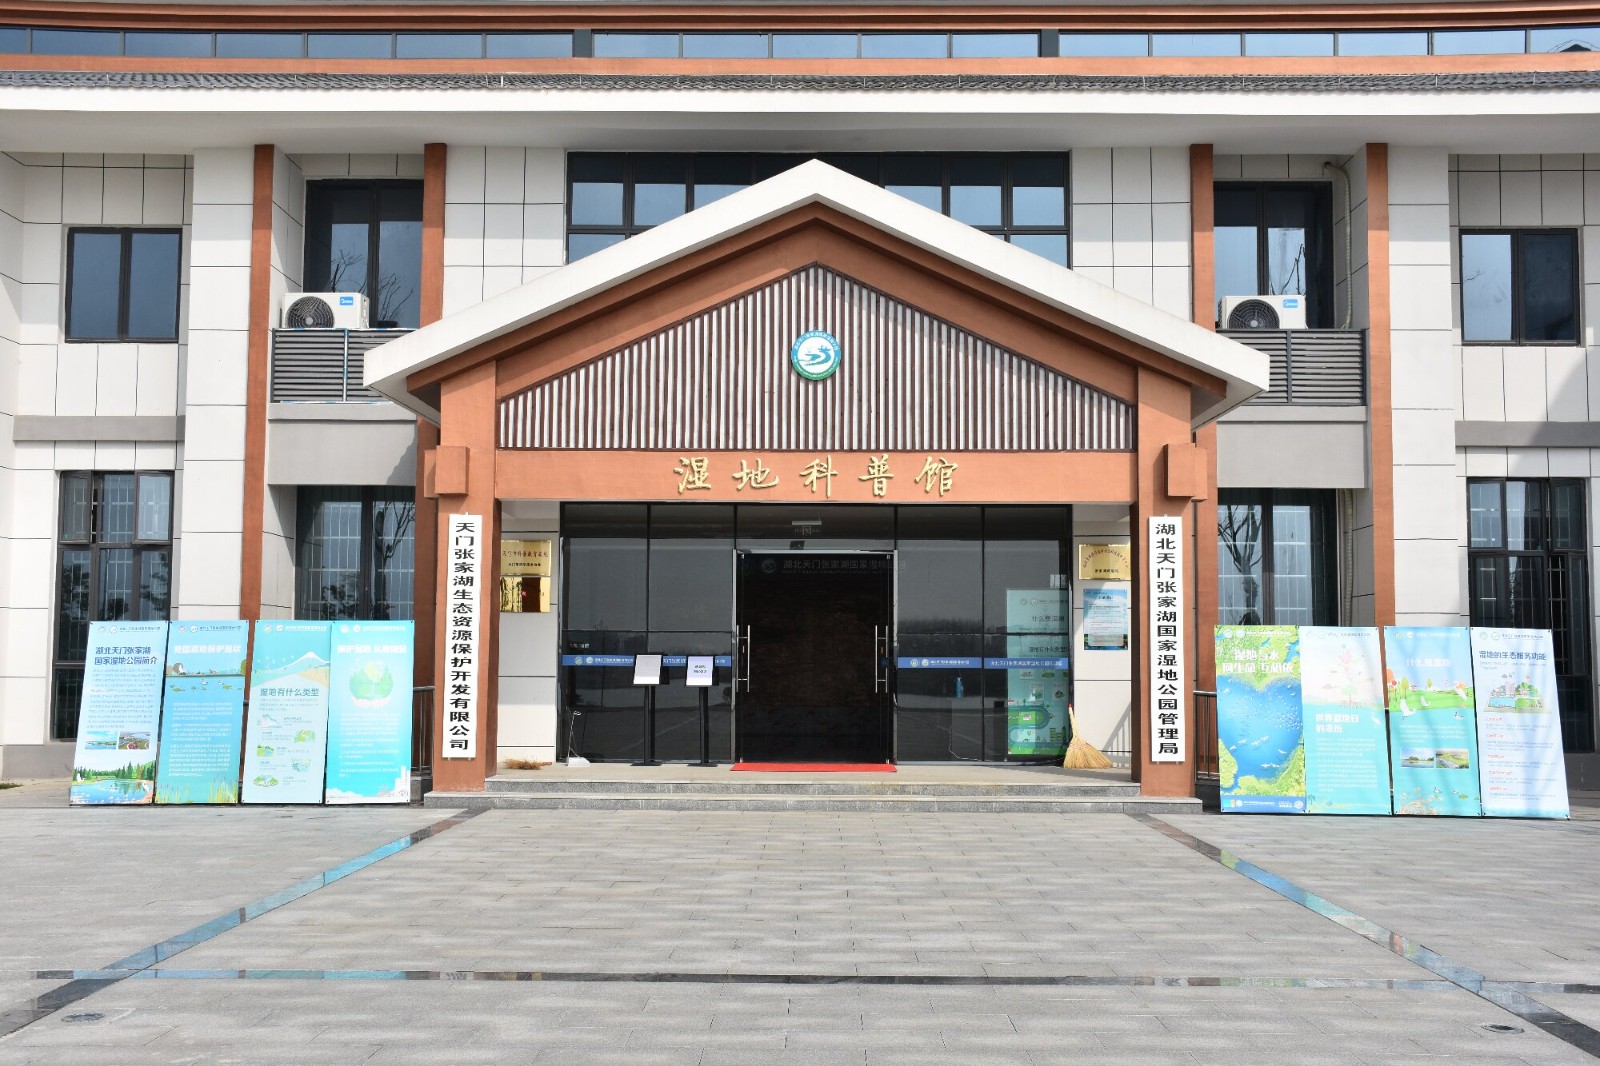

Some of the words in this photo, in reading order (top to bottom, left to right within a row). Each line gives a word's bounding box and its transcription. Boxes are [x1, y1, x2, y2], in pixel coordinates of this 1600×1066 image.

[673, 454, 958, 498] 湿地科普馆
[450, 522, 475, 750] 天门张家湖生态资源保护开发有限公司
[1155, 523, 1179, 755] 湖北天门张家湖国家湿地公园管理局
[95, 646, 151, 655] 湖北天门张家湖
[1479, 650, 1547, 661] 湿地的生态服务功能
[94, 656, 158, 666] 国家湿地公园简介
[260, 688, 319, 697] 湿地有什么类型
